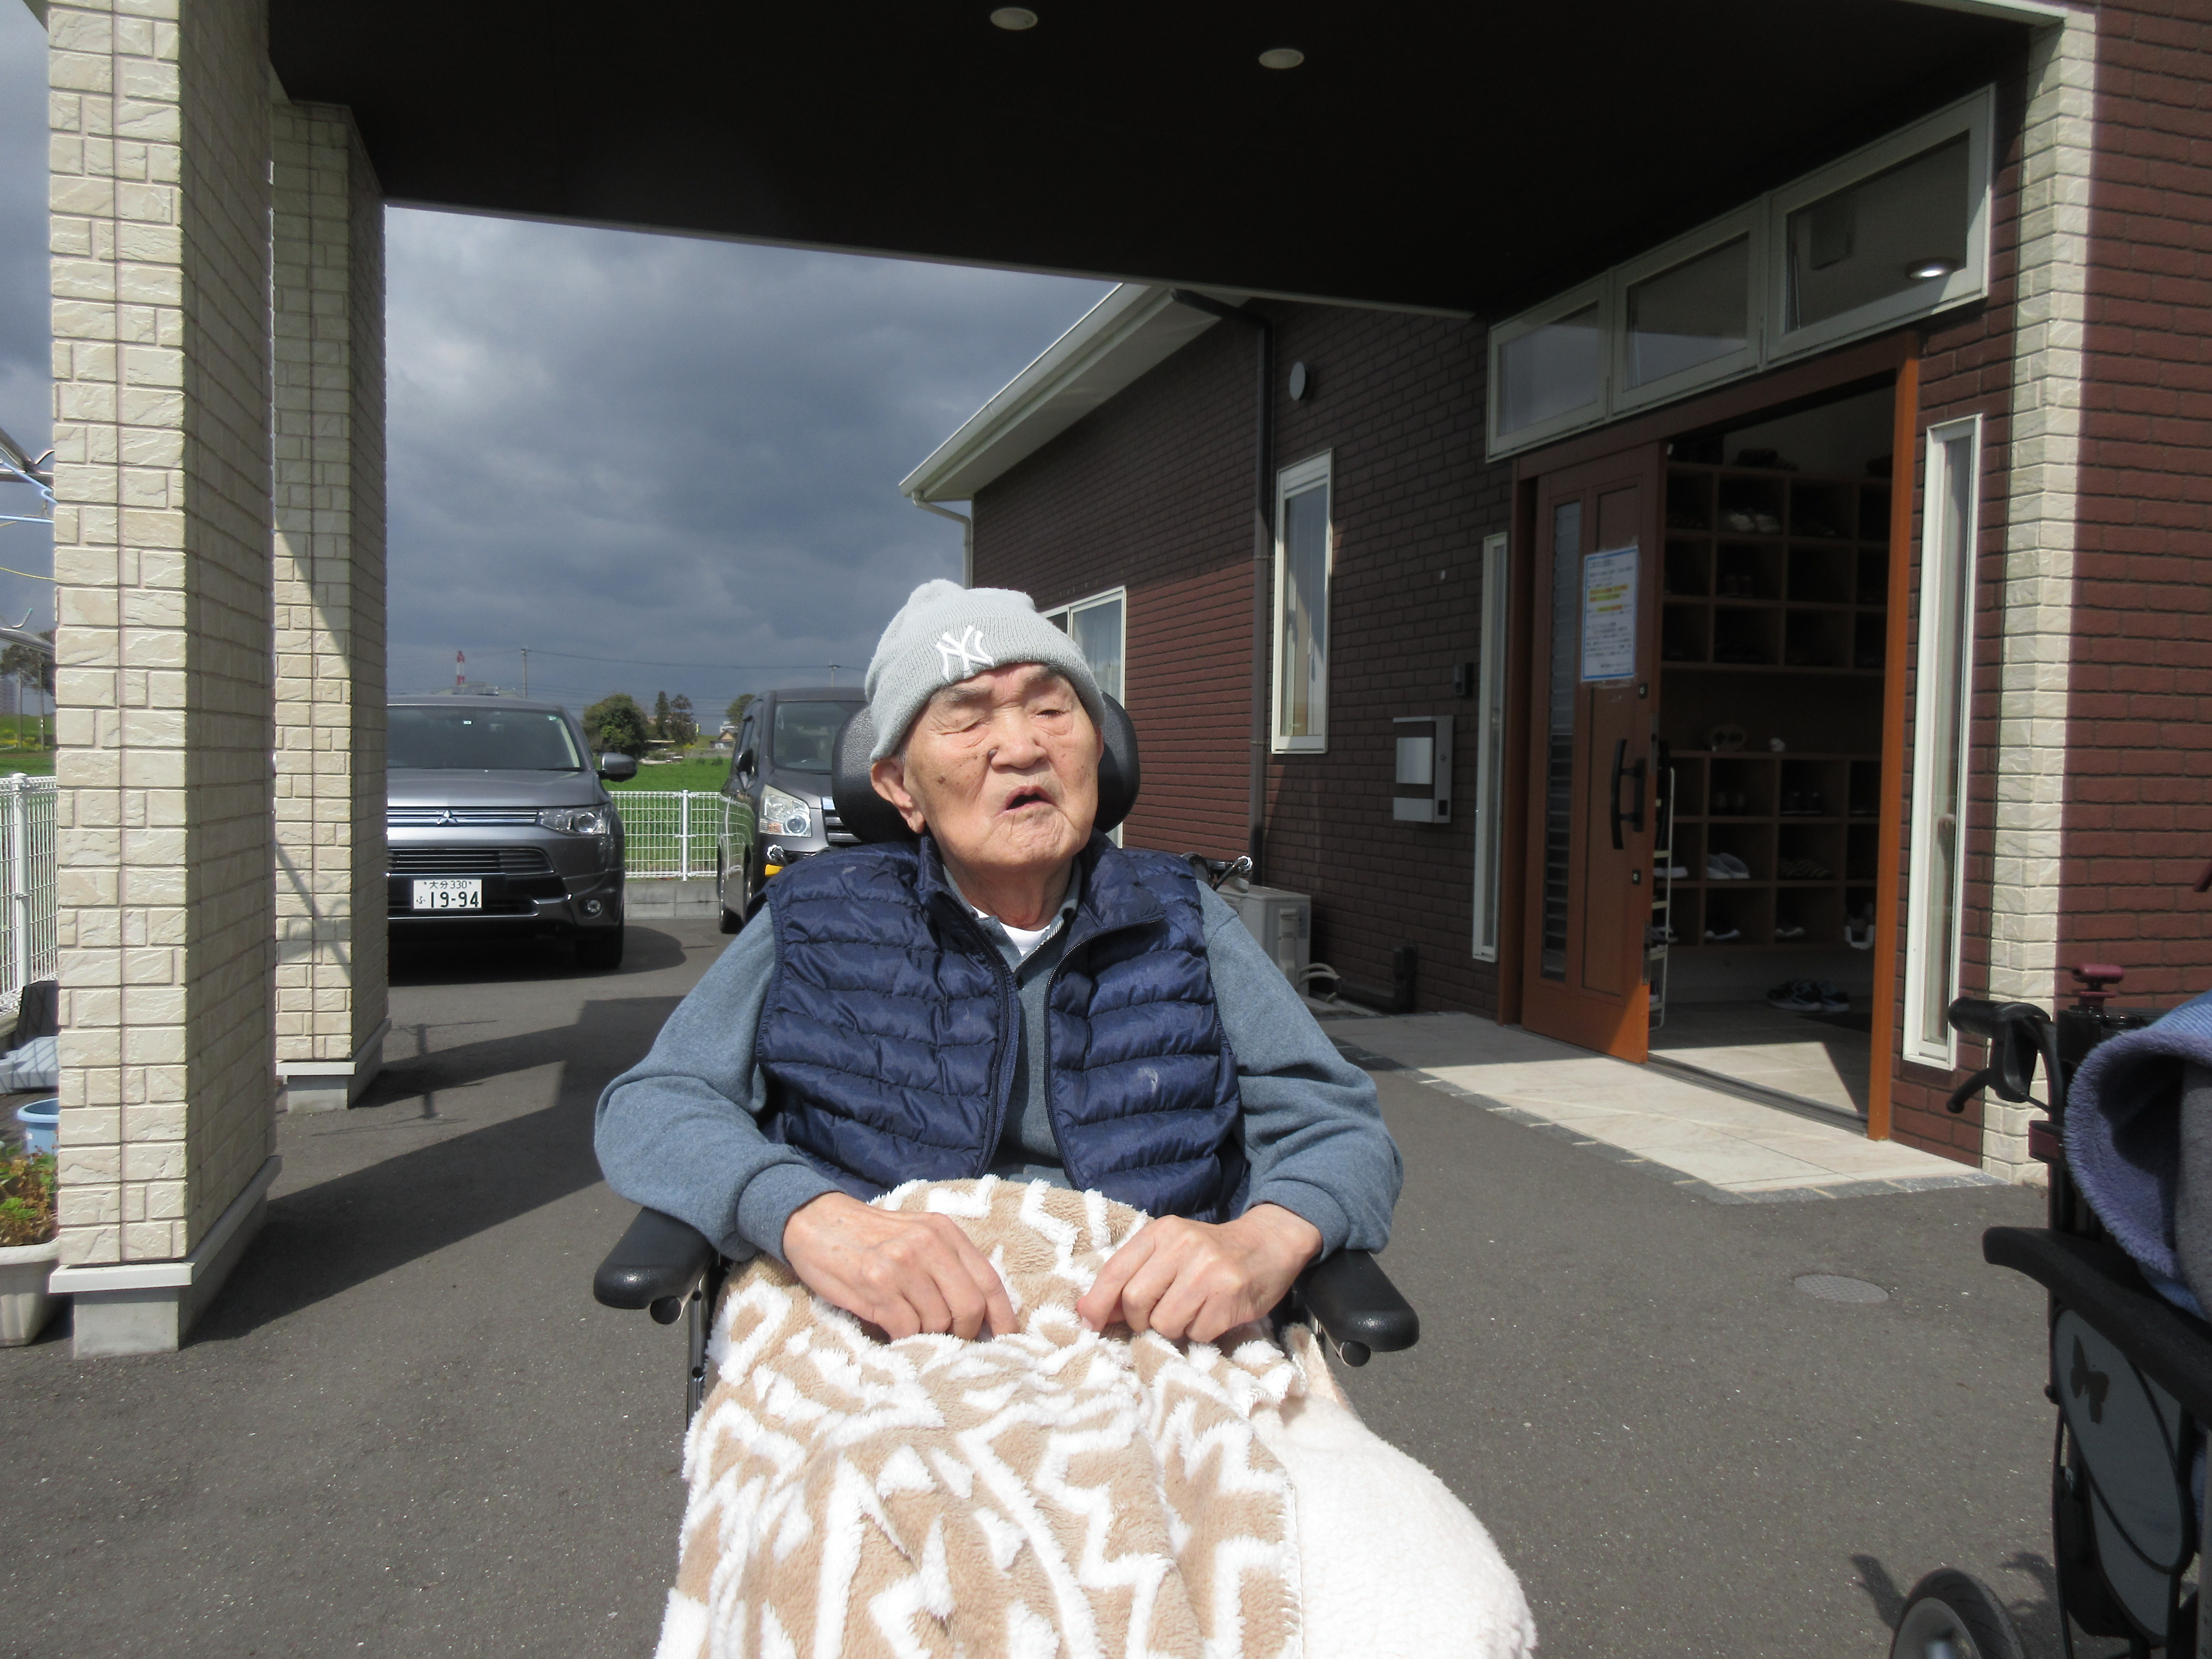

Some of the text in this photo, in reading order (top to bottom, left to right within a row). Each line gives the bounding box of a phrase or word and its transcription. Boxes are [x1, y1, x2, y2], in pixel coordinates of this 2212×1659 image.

[936, 625, 995, 682] NY
[429, 880, 467, 889] 大分 330
[416, 891, 479, 908] ふ 19-94
